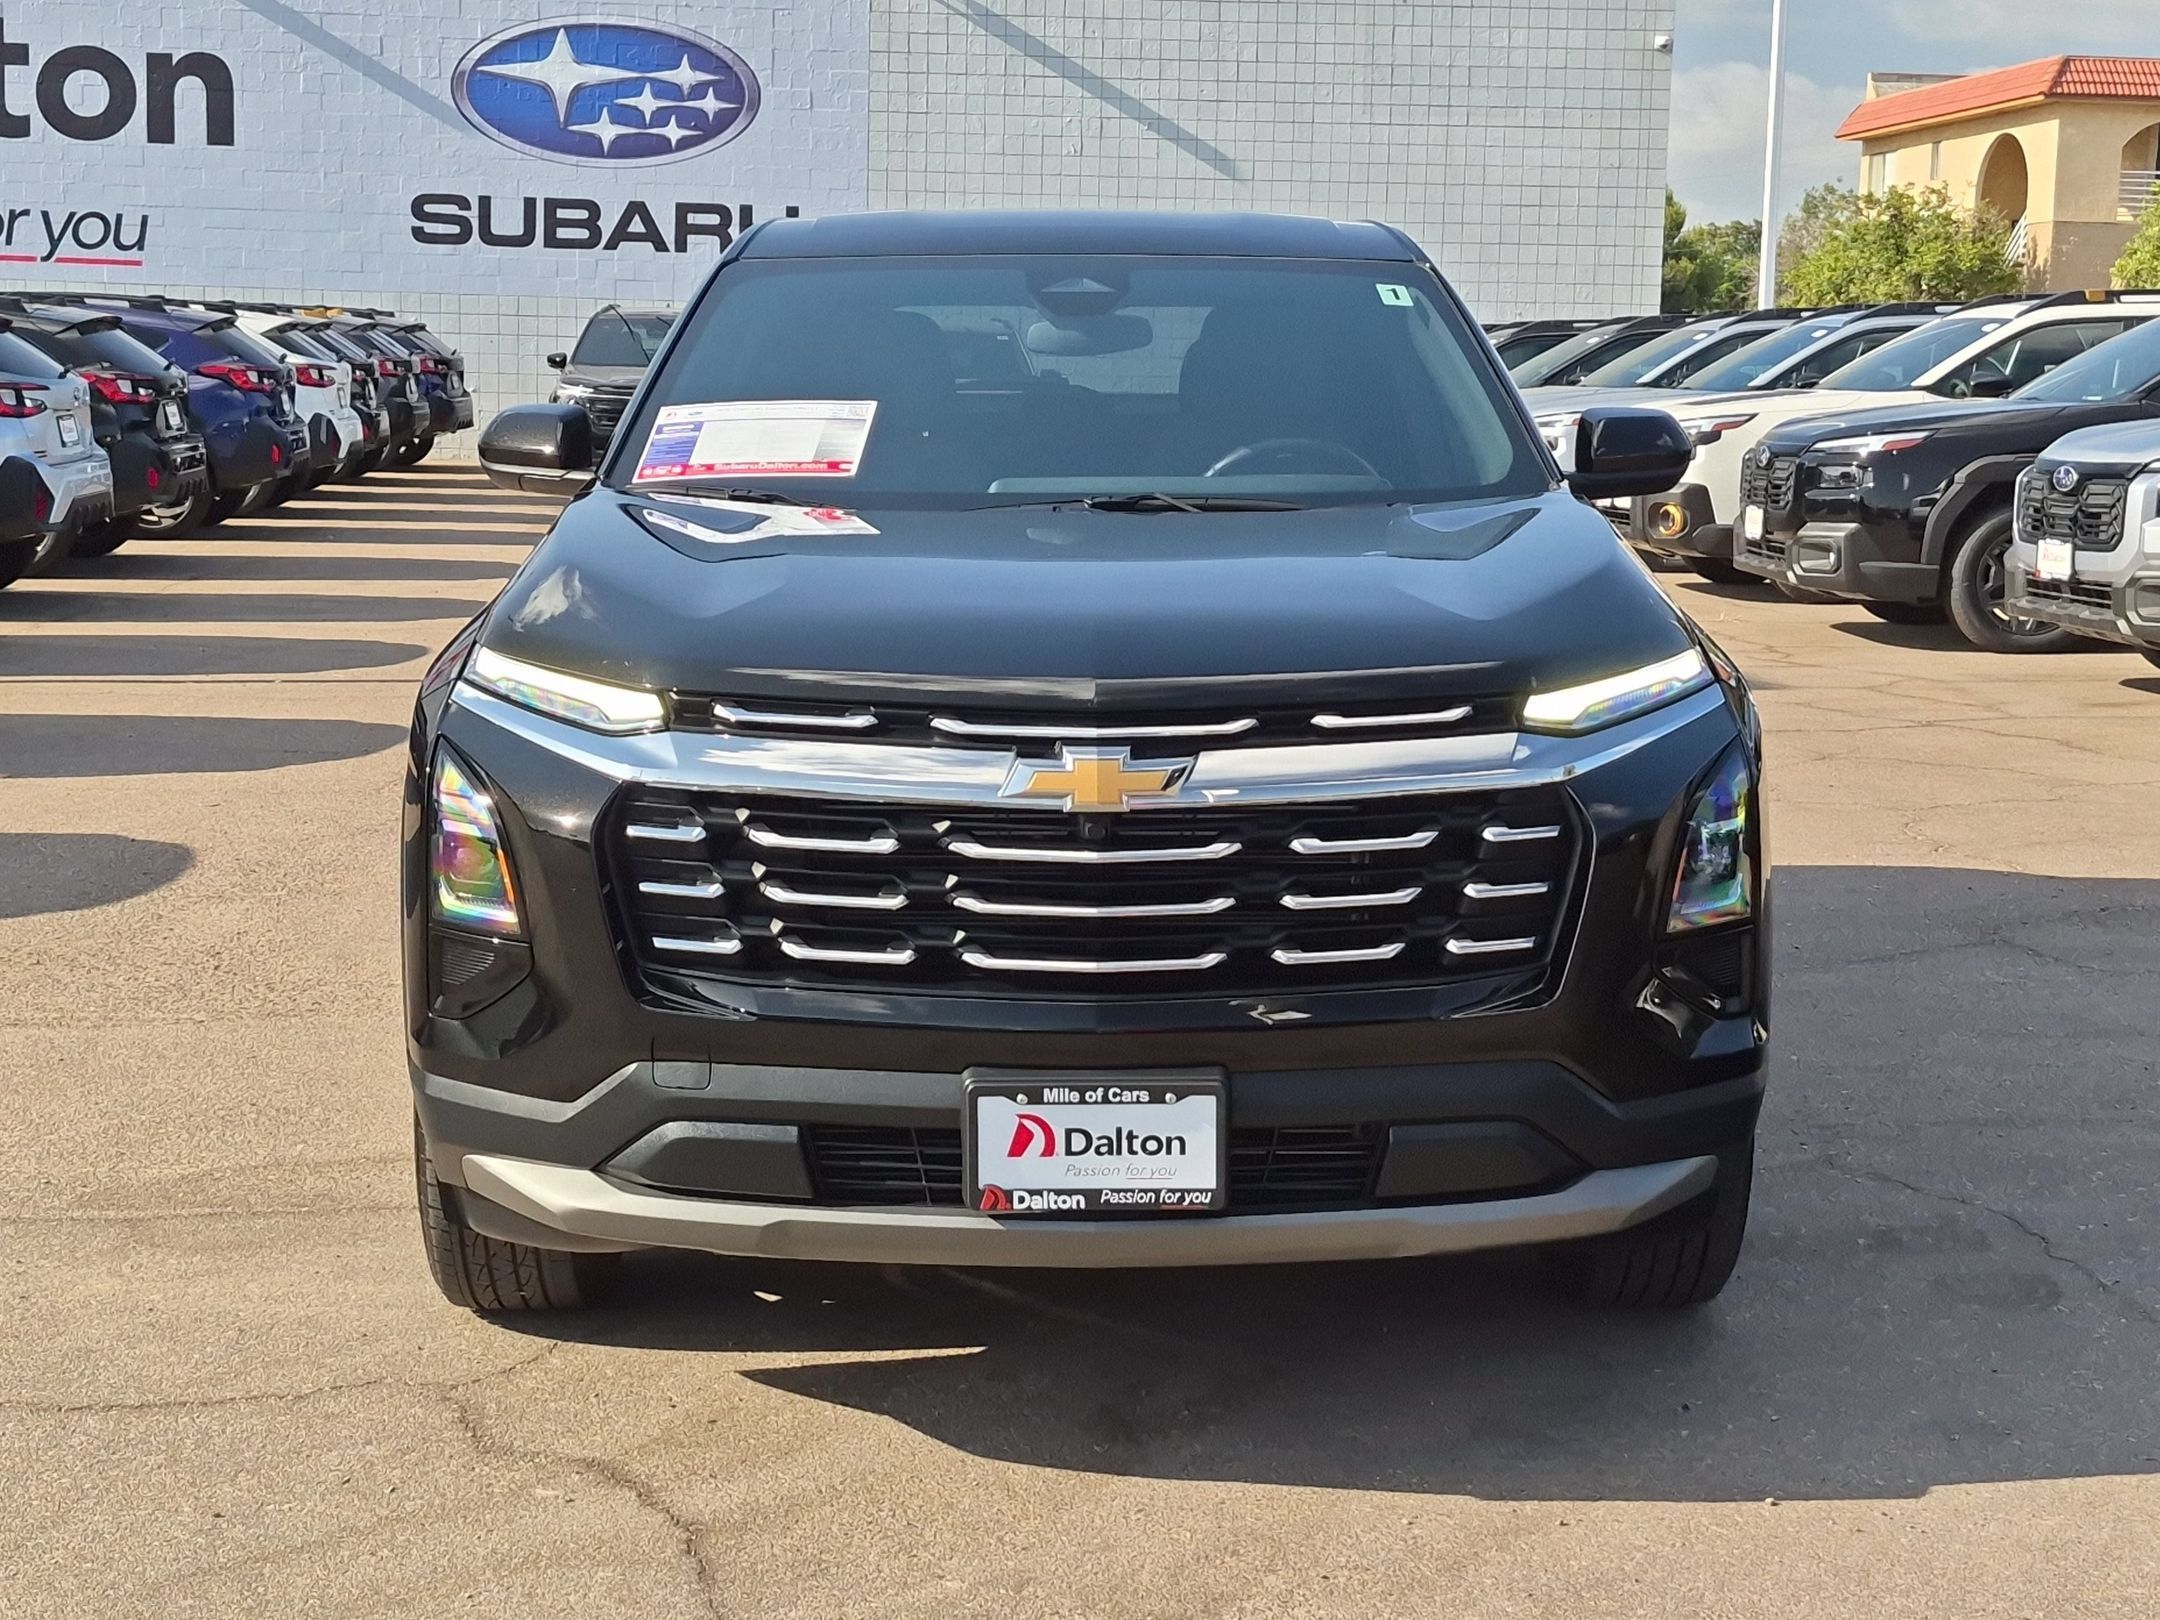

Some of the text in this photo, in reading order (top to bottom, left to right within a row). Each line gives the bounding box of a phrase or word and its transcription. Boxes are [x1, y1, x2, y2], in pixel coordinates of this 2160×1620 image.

[40, 210, 149, 262] you
[1043, 1086, 1150, 1103] Mile of Cars
[1064, 1126, 1187, 1156] Dalton
[1064, 1162, 1178, 1179] Passion for you
[1012, 1189, 1212, 1210] Dalton Passion for you
